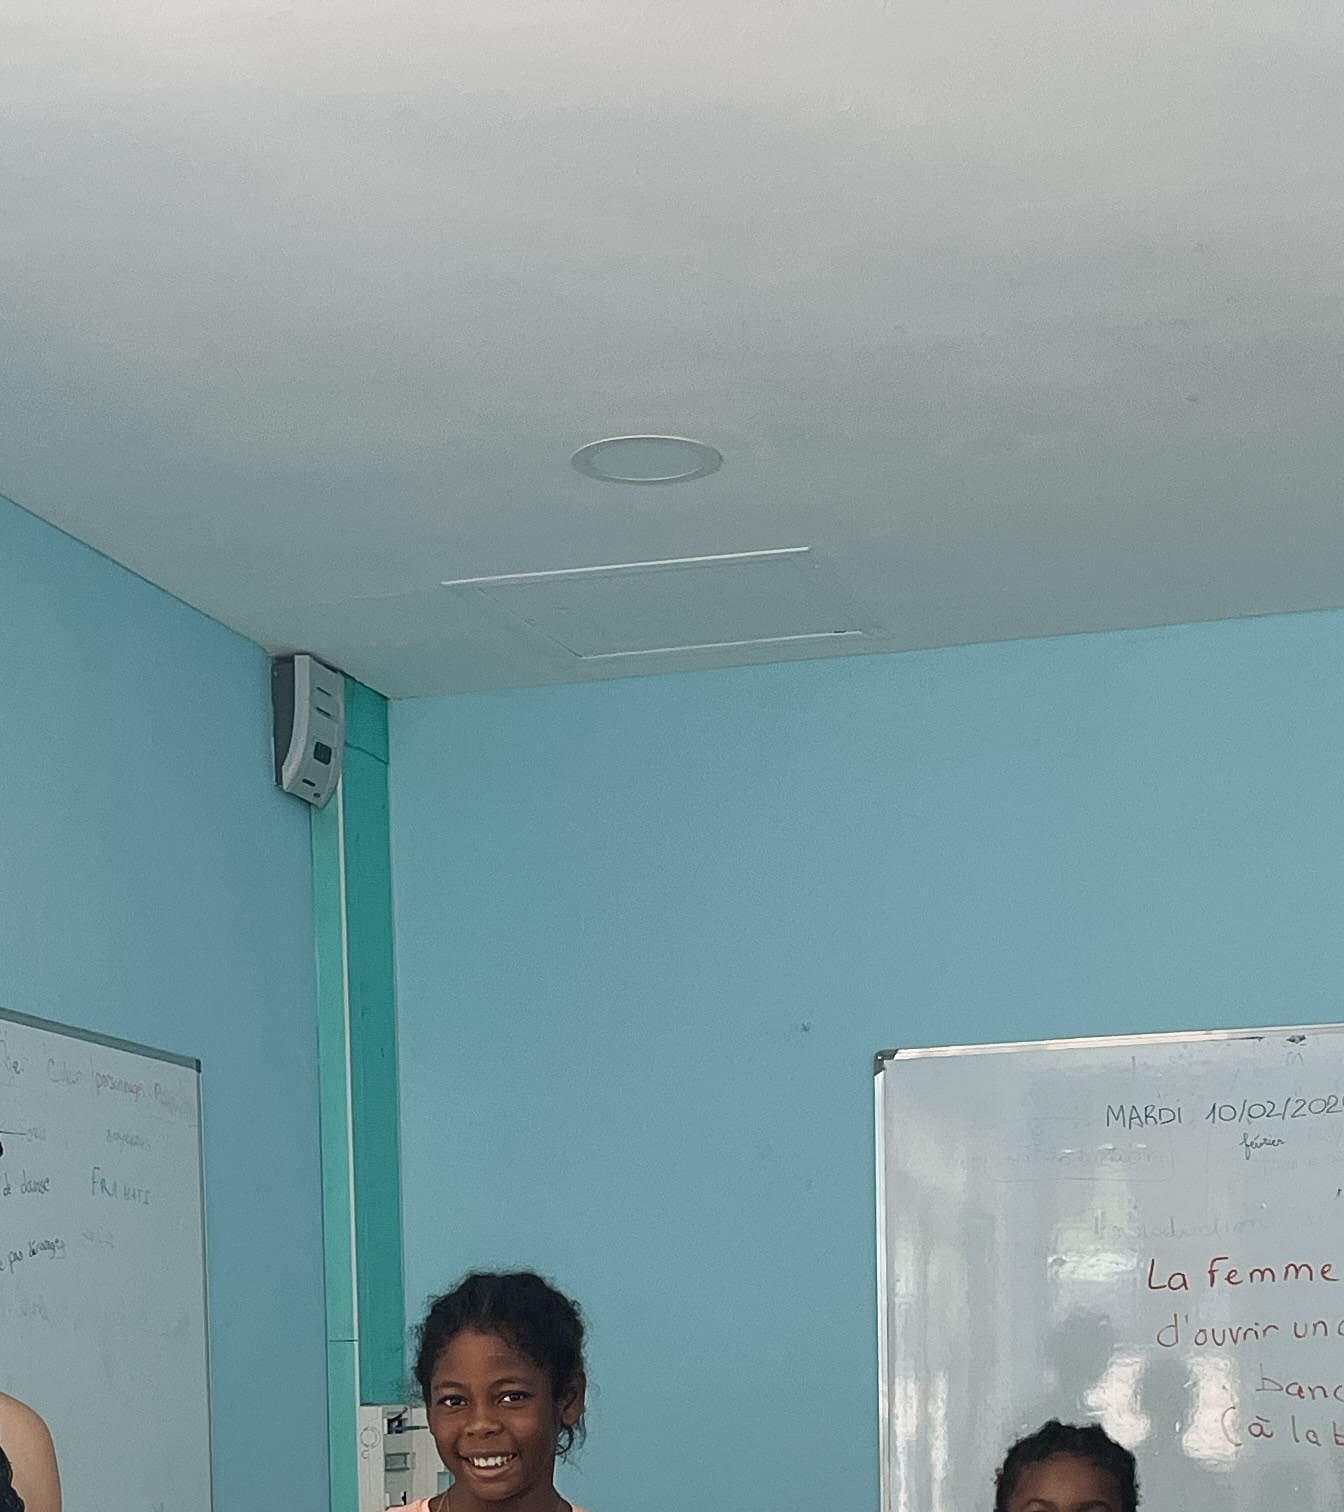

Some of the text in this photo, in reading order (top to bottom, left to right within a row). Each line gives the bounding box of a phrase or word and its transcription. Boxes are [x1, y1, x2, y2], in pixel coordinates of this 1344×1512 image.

[1239, 1132, 1287, 1161] février
[1147, 1257, 1189, 1292] La
[1156, 1313, 1280, 1348] d'ouvrir
